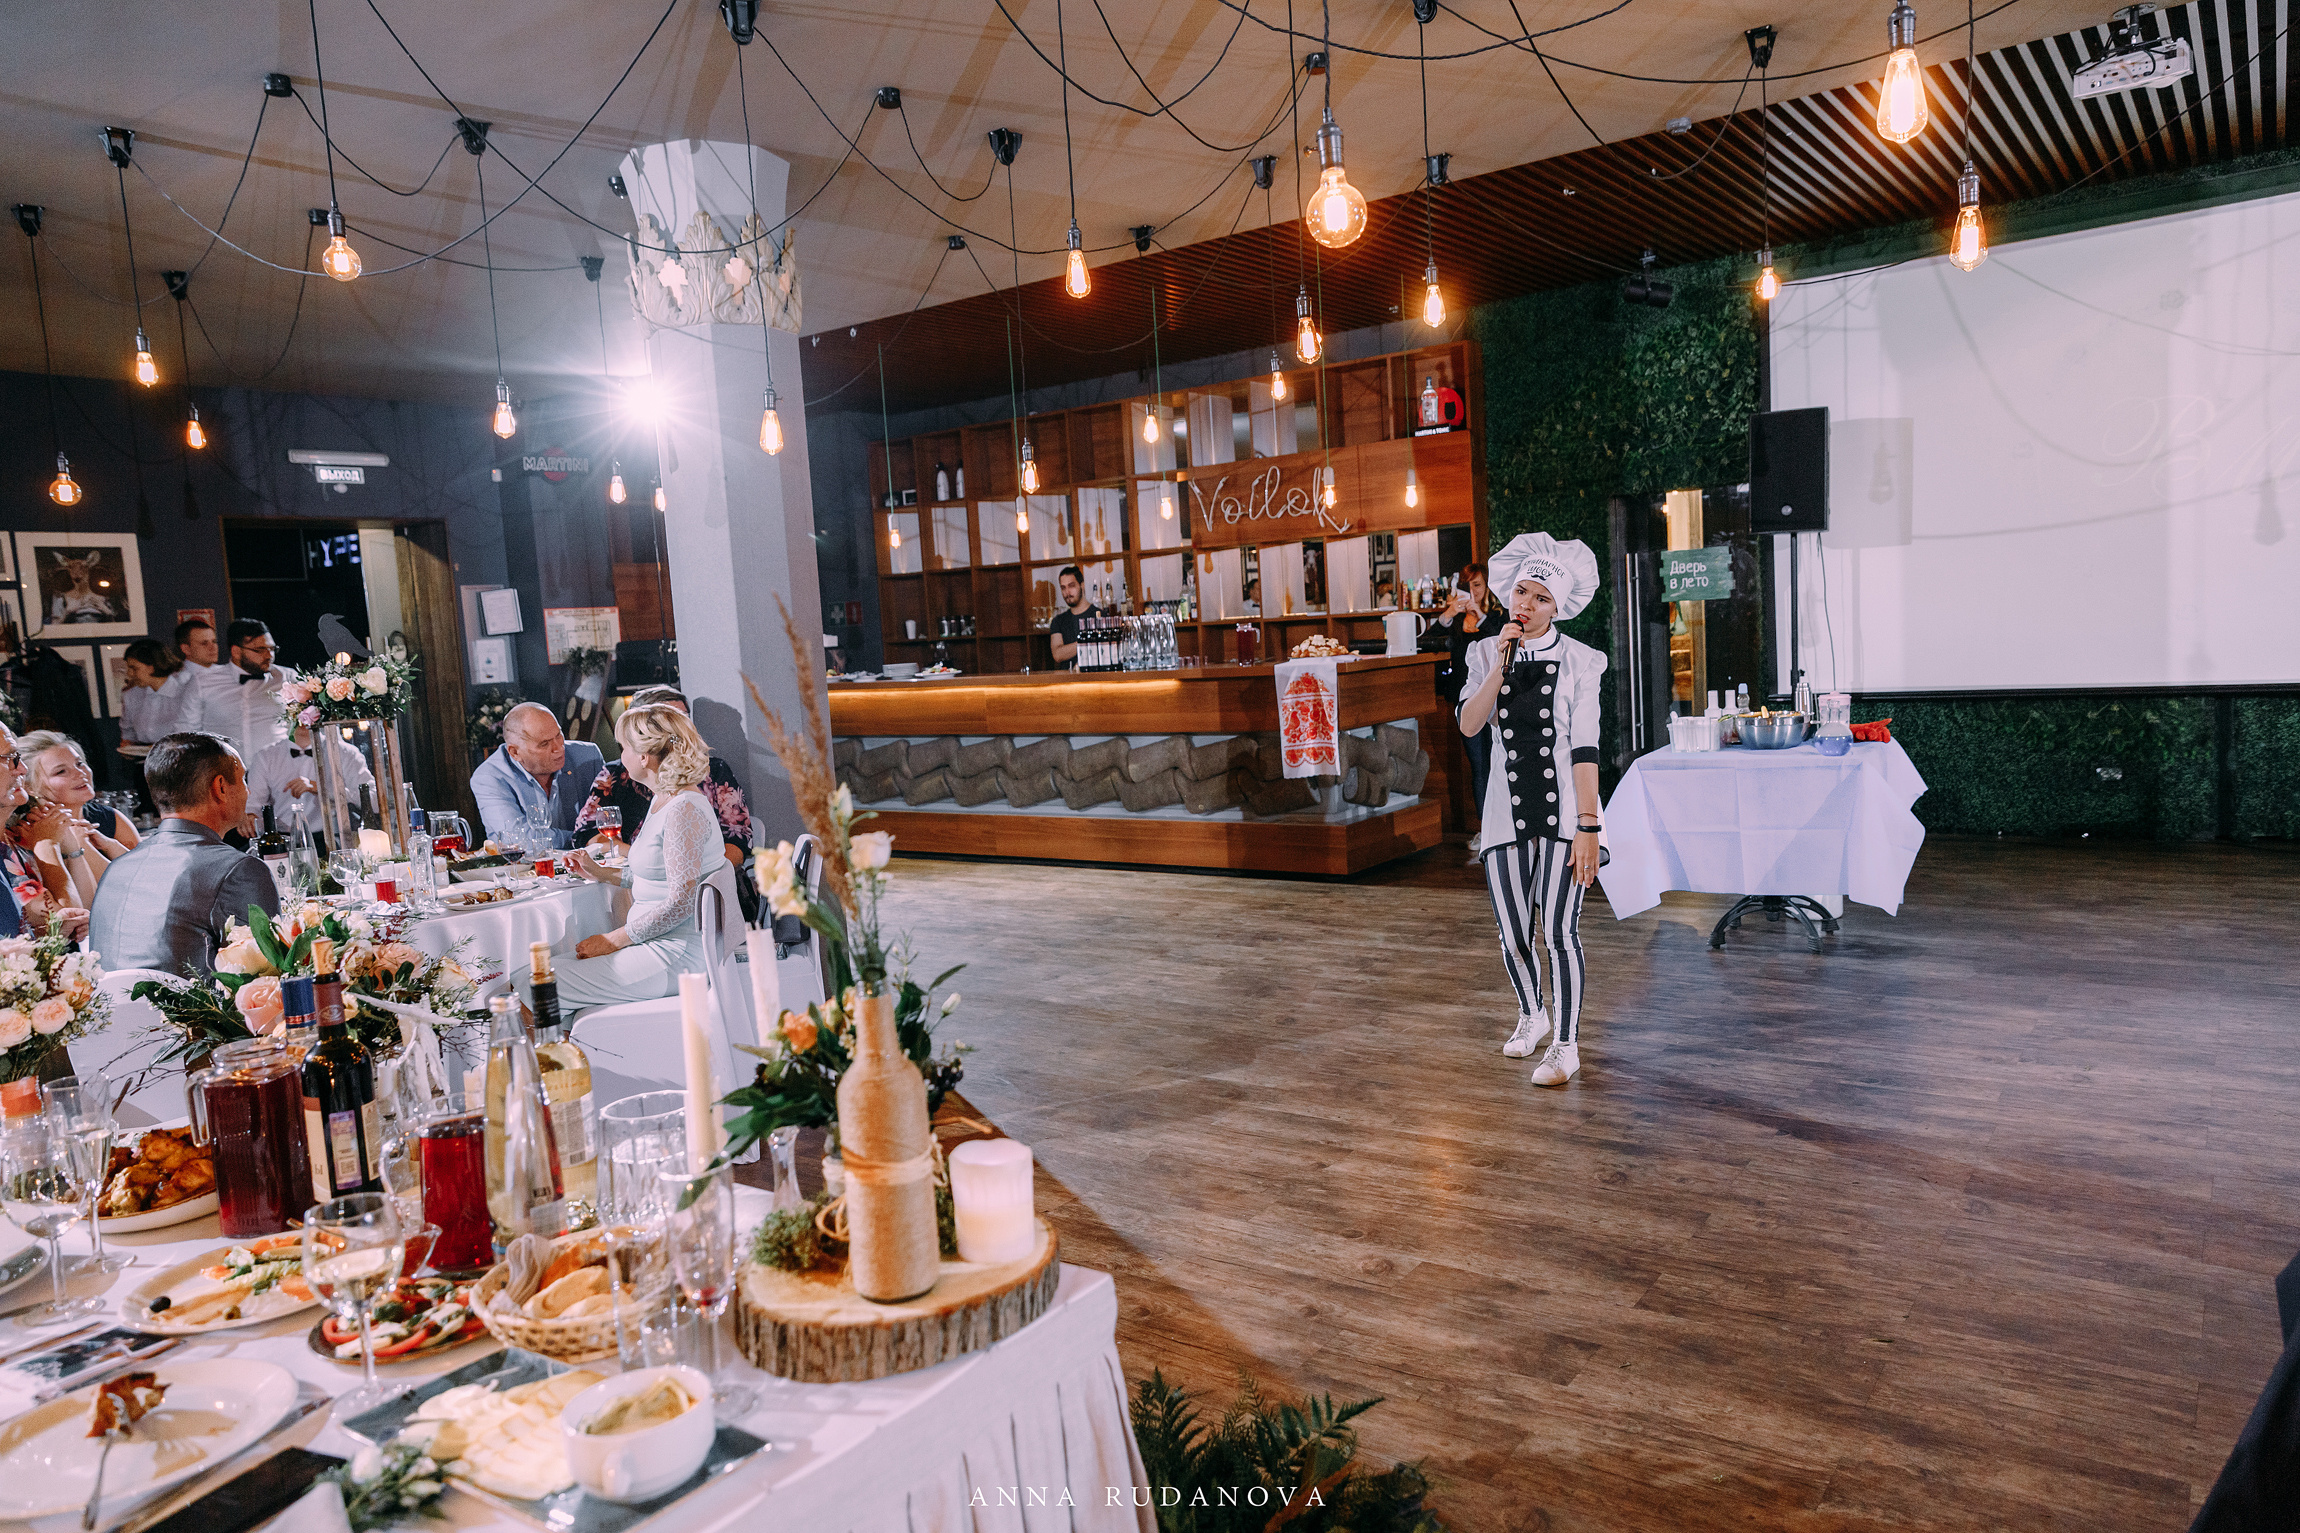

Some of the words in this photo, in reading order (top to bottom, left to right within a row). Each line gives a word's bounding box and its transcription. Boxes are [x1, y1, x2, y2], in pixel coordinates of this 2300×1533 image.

[522, 456, 589, 473] MARTINI
[319, 468, 360, 482] ВЫХОД
[306, 533, 361, 568] HYPE
[1669, 560, 1707, 577] Дверь
[1669, 578, 1678, 590] в
[1680, 576, 1709, 590] лето
